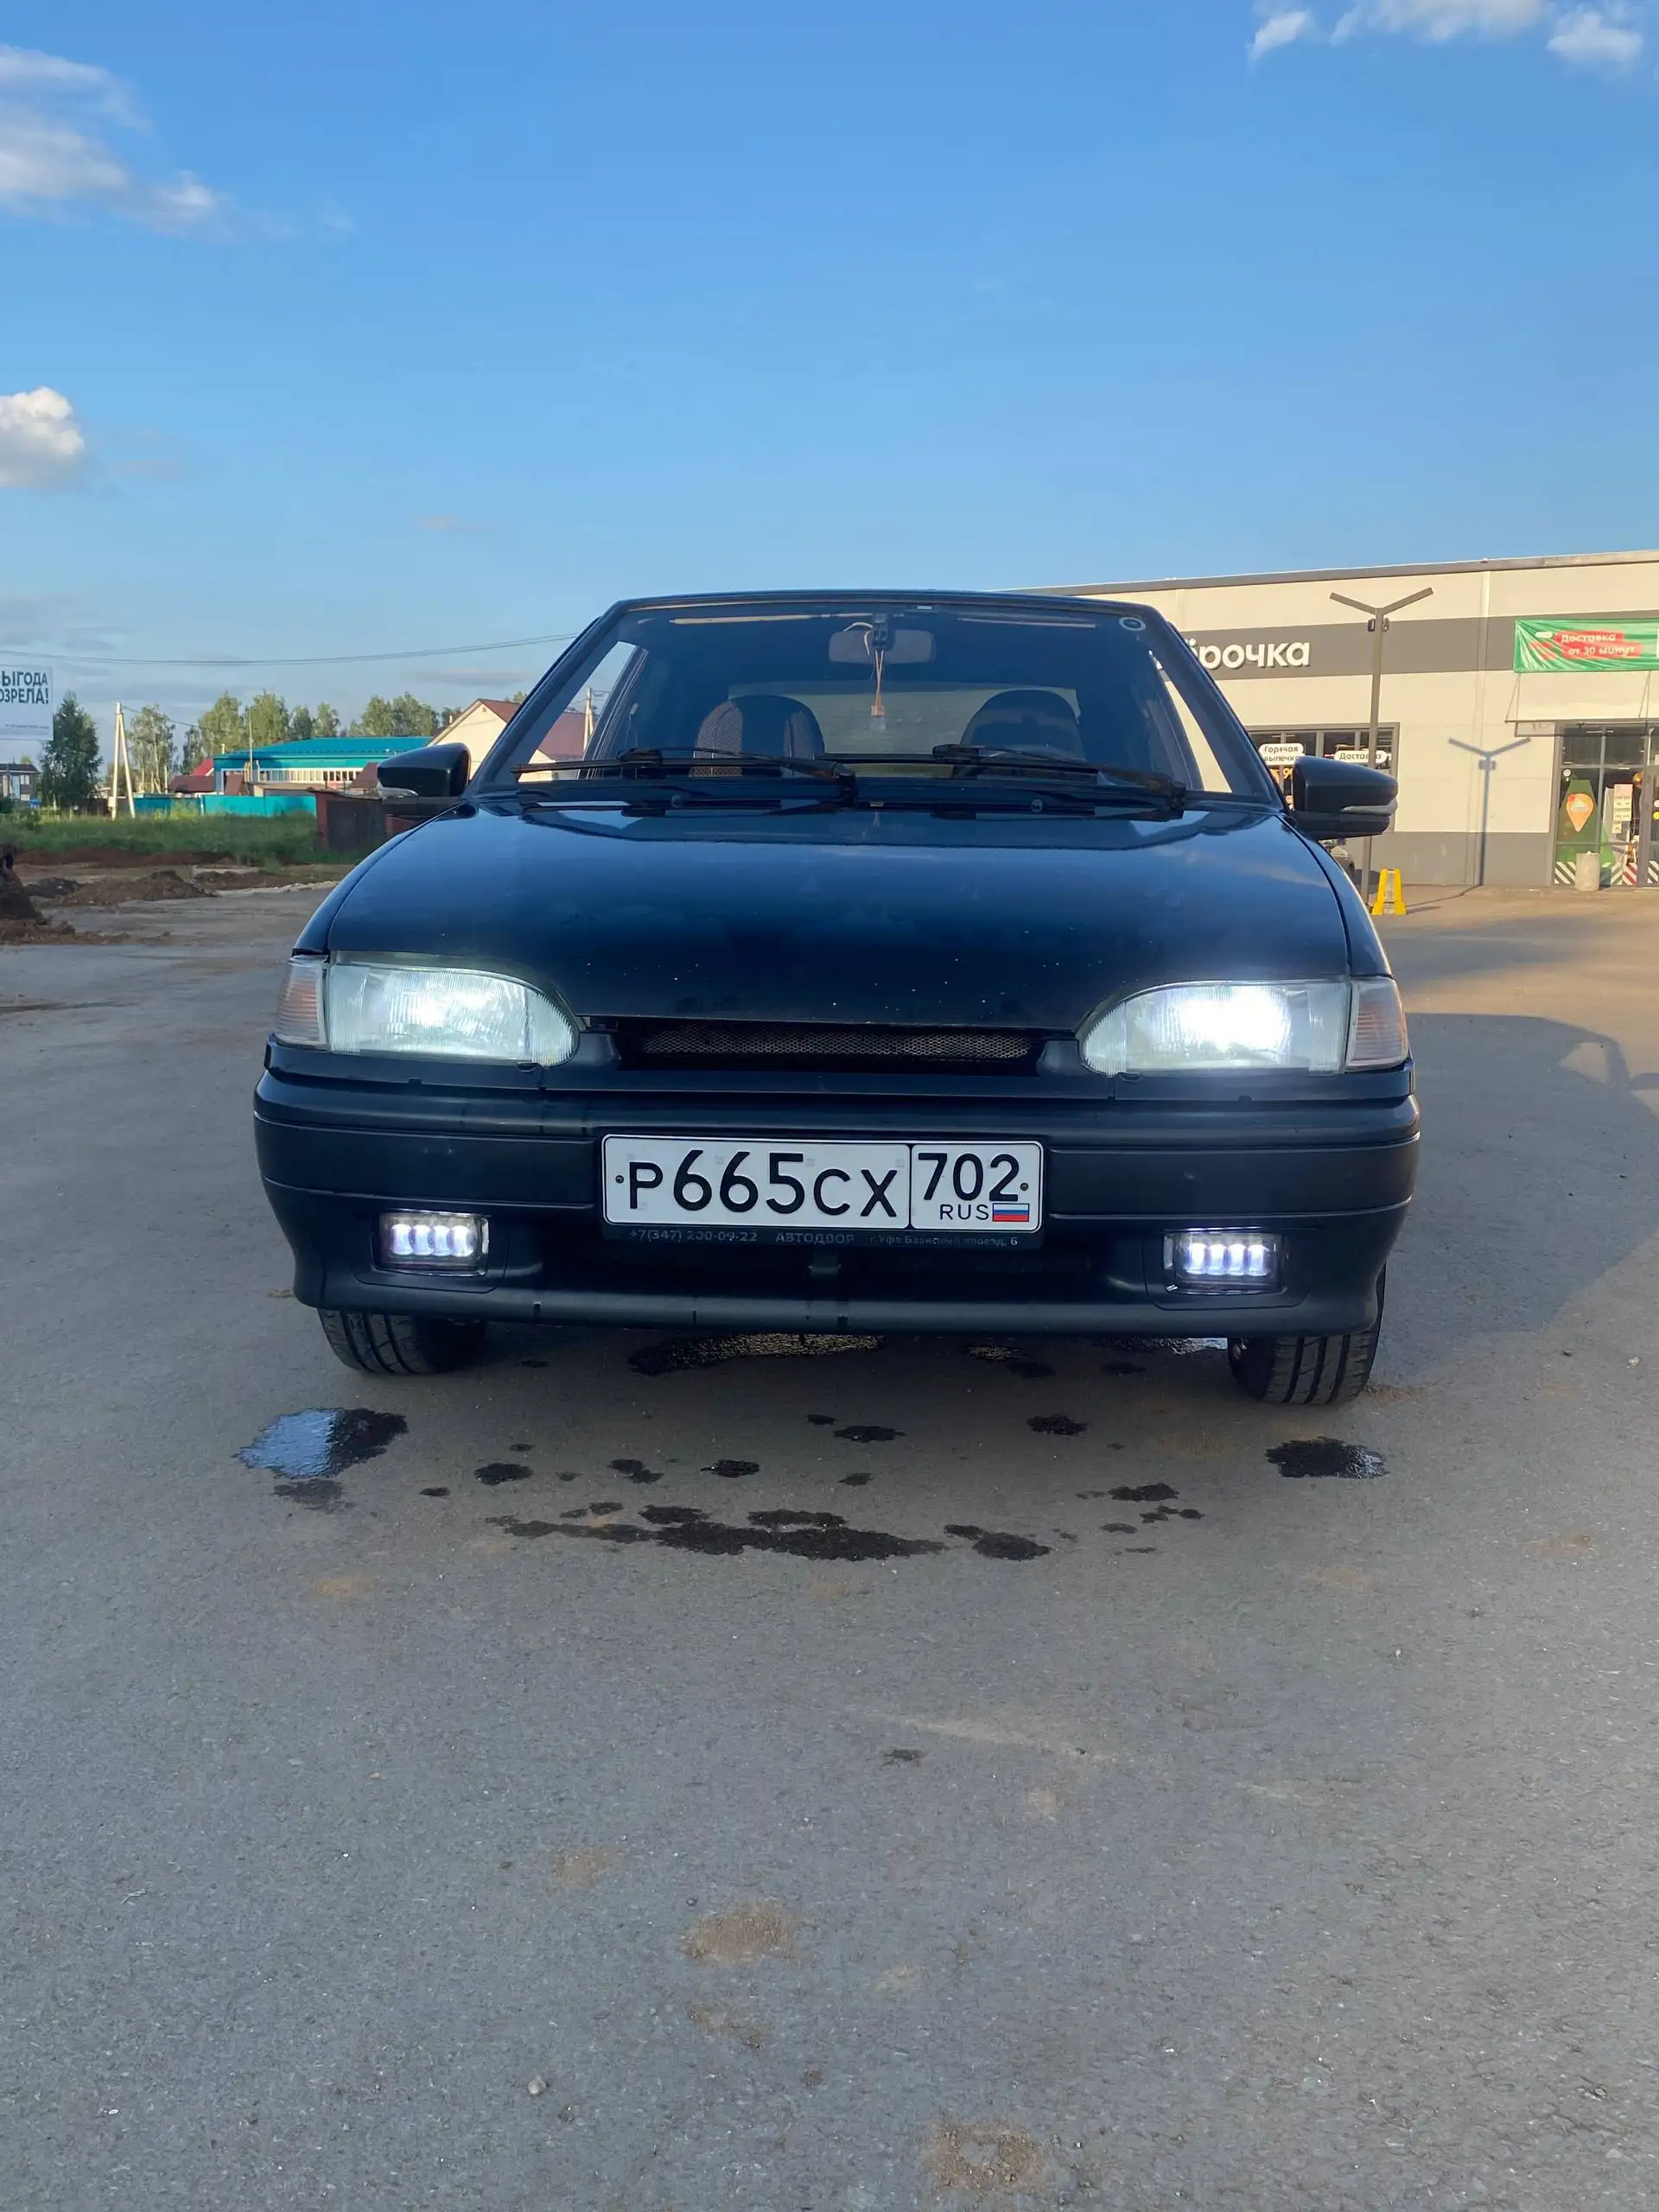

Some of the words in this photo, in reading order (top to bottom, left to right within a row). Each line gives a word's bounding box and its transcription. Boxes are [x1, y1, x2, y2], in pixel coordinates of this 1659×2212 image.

[1560, 634, 1617, 643] Доставка
[1584, 646, 1596, 656] 30
[1599, 645, 1636, 657] минут
[0, 671, 48, 687] ЫГОДА
[628, 1149, 898, 1217] Р665СХ
[918, 1153, 1020, 1202] 702
[939, 1204, 989, 1221] RUS
[774, 1232, 855, 1245] АВТОДВОР
